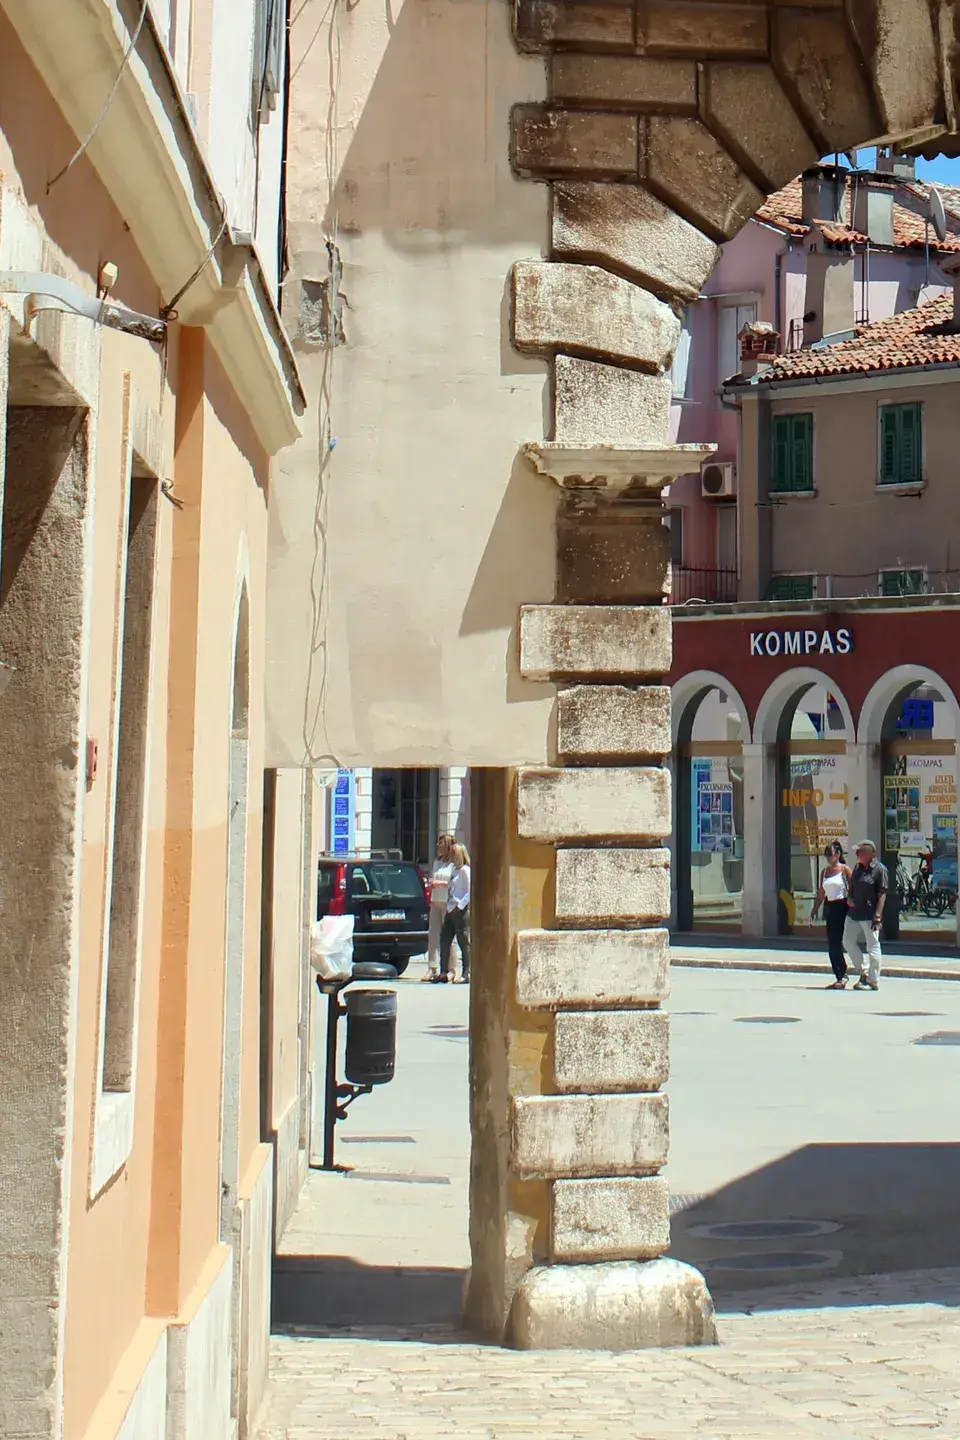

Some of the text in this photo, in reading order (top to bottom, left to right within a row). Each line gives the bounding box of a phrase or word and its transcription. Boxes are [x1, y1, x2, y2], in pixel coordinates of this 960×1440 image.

[750, 628, 850, 656] KOMPAS
[912, 759, 943, 768] KOMPAS
[885, 777, 920, 786] EXCURSIONS
[782, 788, 824, 807] INFO
